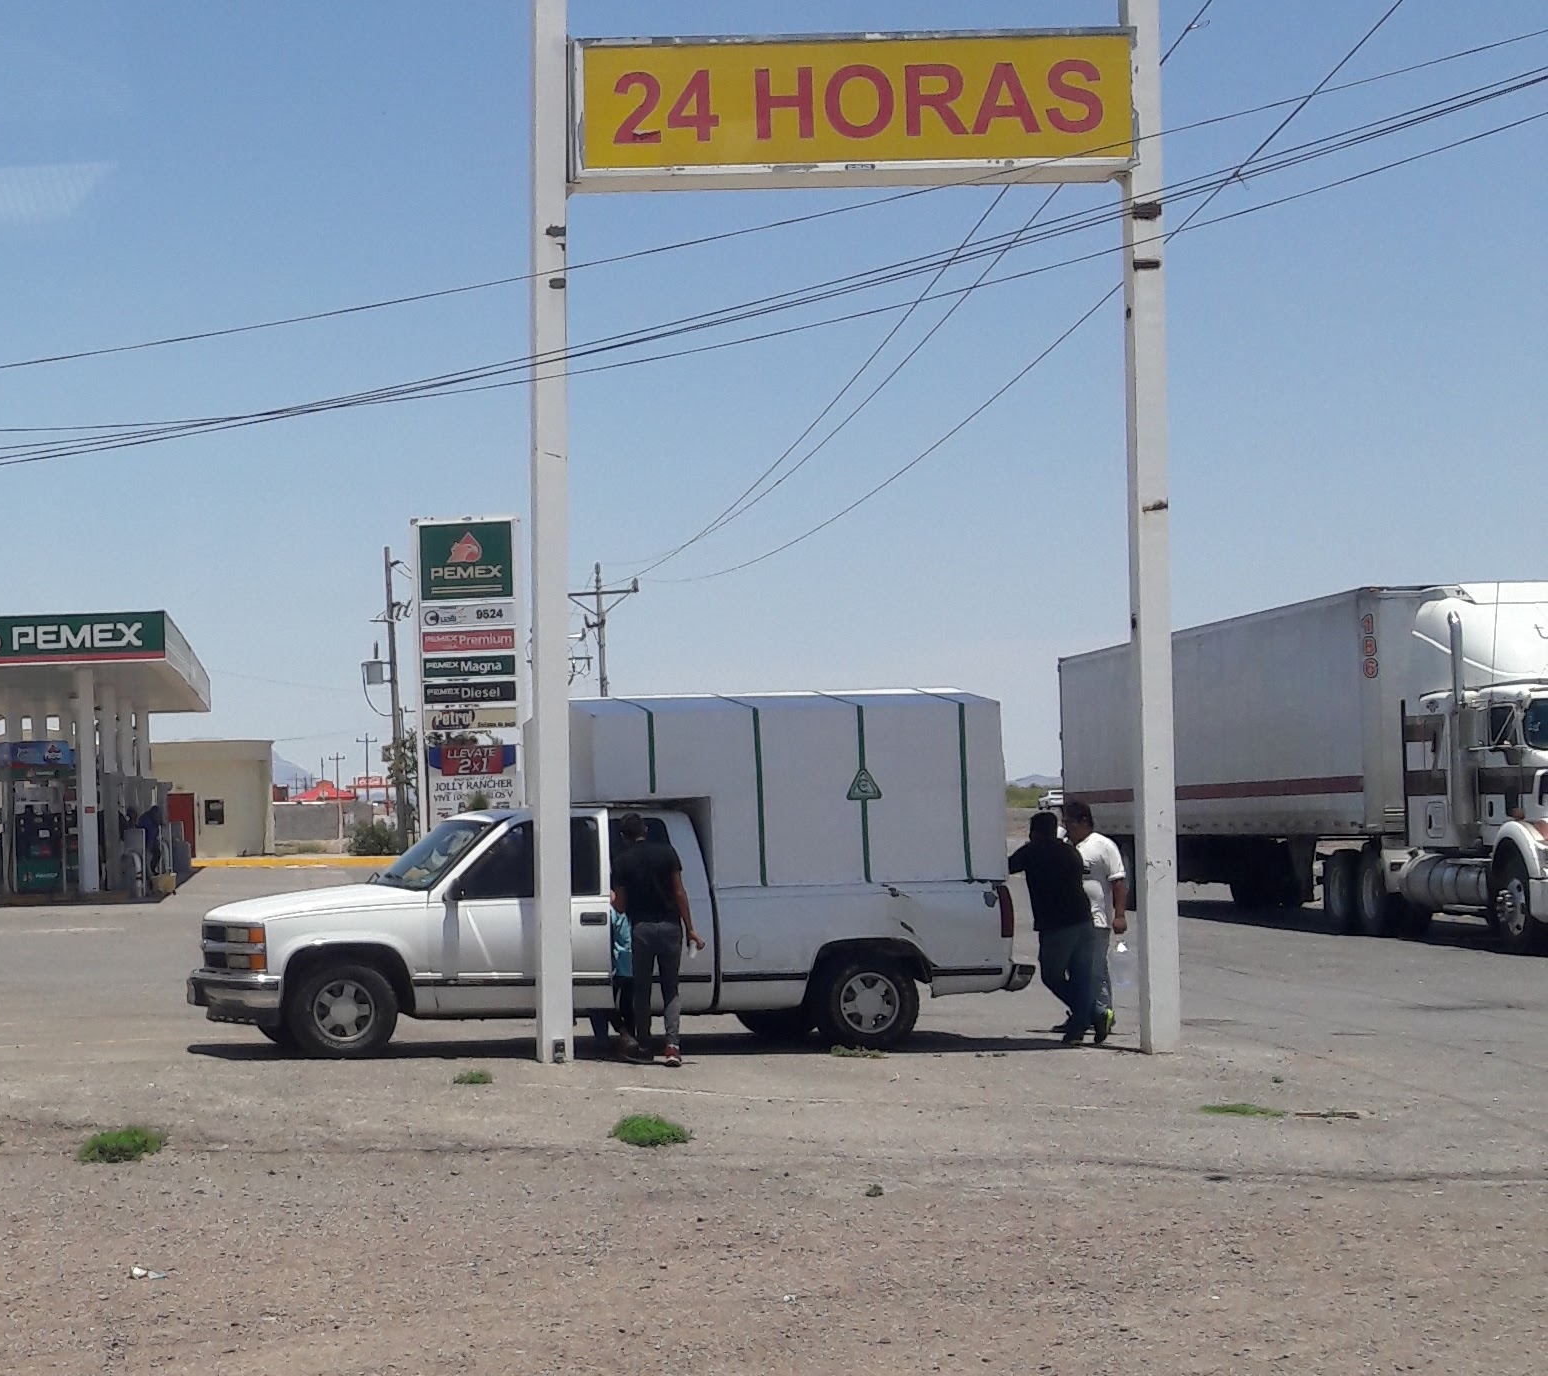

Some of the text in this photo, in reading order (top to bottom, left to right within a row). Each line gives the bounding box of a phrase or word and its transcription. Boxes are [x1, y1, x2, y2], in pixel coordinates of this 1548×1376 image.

[612, 58, 1104, 144] 24 HORAS
[429, 565, 502, 580] PEMEX
[11, 621, 143, 651] PEMEX
[459, 633, 512, 645] Premium
[460, 660, 502, 673] Magna
[461, 686, 500, 698] Diesel
[457, 758, 488, 773] 2x1
[435, 780, 463, 791] JOLLY
[466, 778, 512, 789] RANCHER
